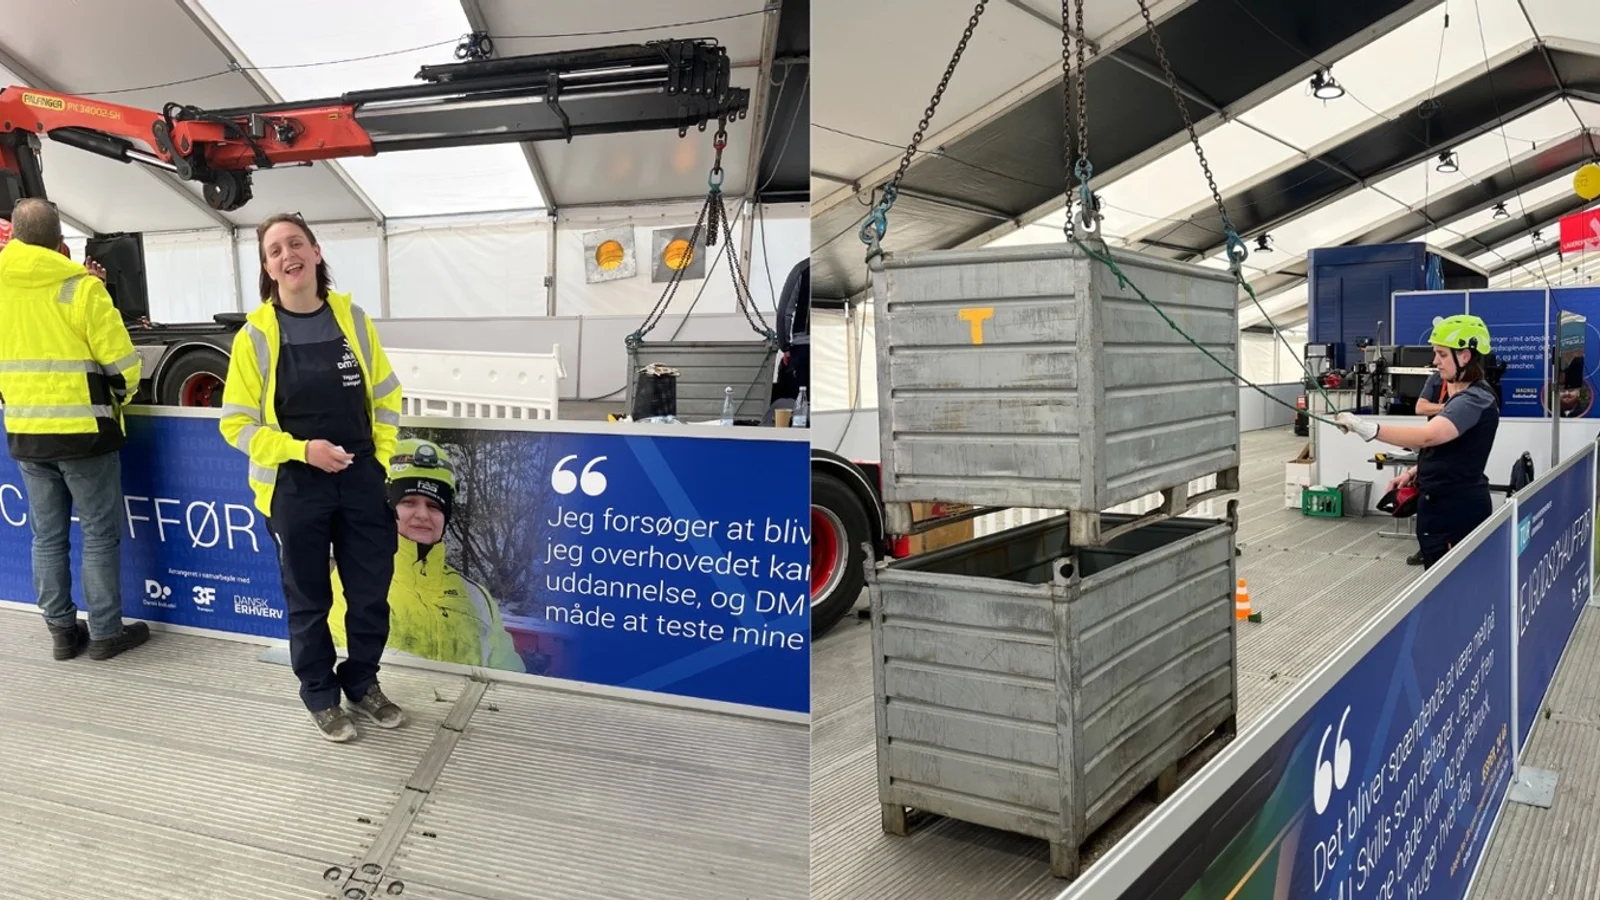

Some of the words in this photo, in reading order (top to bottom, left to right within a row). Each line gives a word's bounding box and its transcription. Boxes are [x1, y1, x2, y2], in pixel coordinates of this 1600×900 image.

[24, 94, 63, 109] PALFINGER
[958, 308, 994, 344] T
[548, 506, 594, 534] Jeg
[603, 507, 719, 542] forsøger
[726, 518, 754, 542] at
[202, 572, 236, 583] samarbejde
[544, 537, 583, 566] jeg
[591, 545, 760, 579] overhovedet
[192, 585, 216, 605] 3F
[234, 594, 268, 608] DANSK
[234, 604, 284, 619] ERHVERV
[546, 571, 701, 609] uddannelse,
[711, 591, 745, 616] og
[755, 590, 805, 616] DM
[544, 603, 616, 629] måde
[623, 613, 648, 634] at
[656, 614, 725, 642] teste
[732, 624, 804, 650] mine
[1314, 821, 1343, 893] Det
[1347, 763, 1386, 843] bliver
[1388, 677, 1445, 783] spændende
[1446, 662, 1454, 695] at
[1455, 641, 1472, 680] være
[1473, 613, 1487, 655] med
[1487, 603, 1495, 641] på
[1357, 814, 1391, 891] Skills
[1394, 772, 1418, 830] som
[1456, 688, 1469, 723] Jeg
[1471, 668, 1481, 700] ser
[1481, 648, 1494, 684] frem
[1397, 815, 1422, 883] både
[1424, 778, 1443, 831] kran
[1445, 756, 1455, 790] og
[1439, 798, 1456, 850] hver
